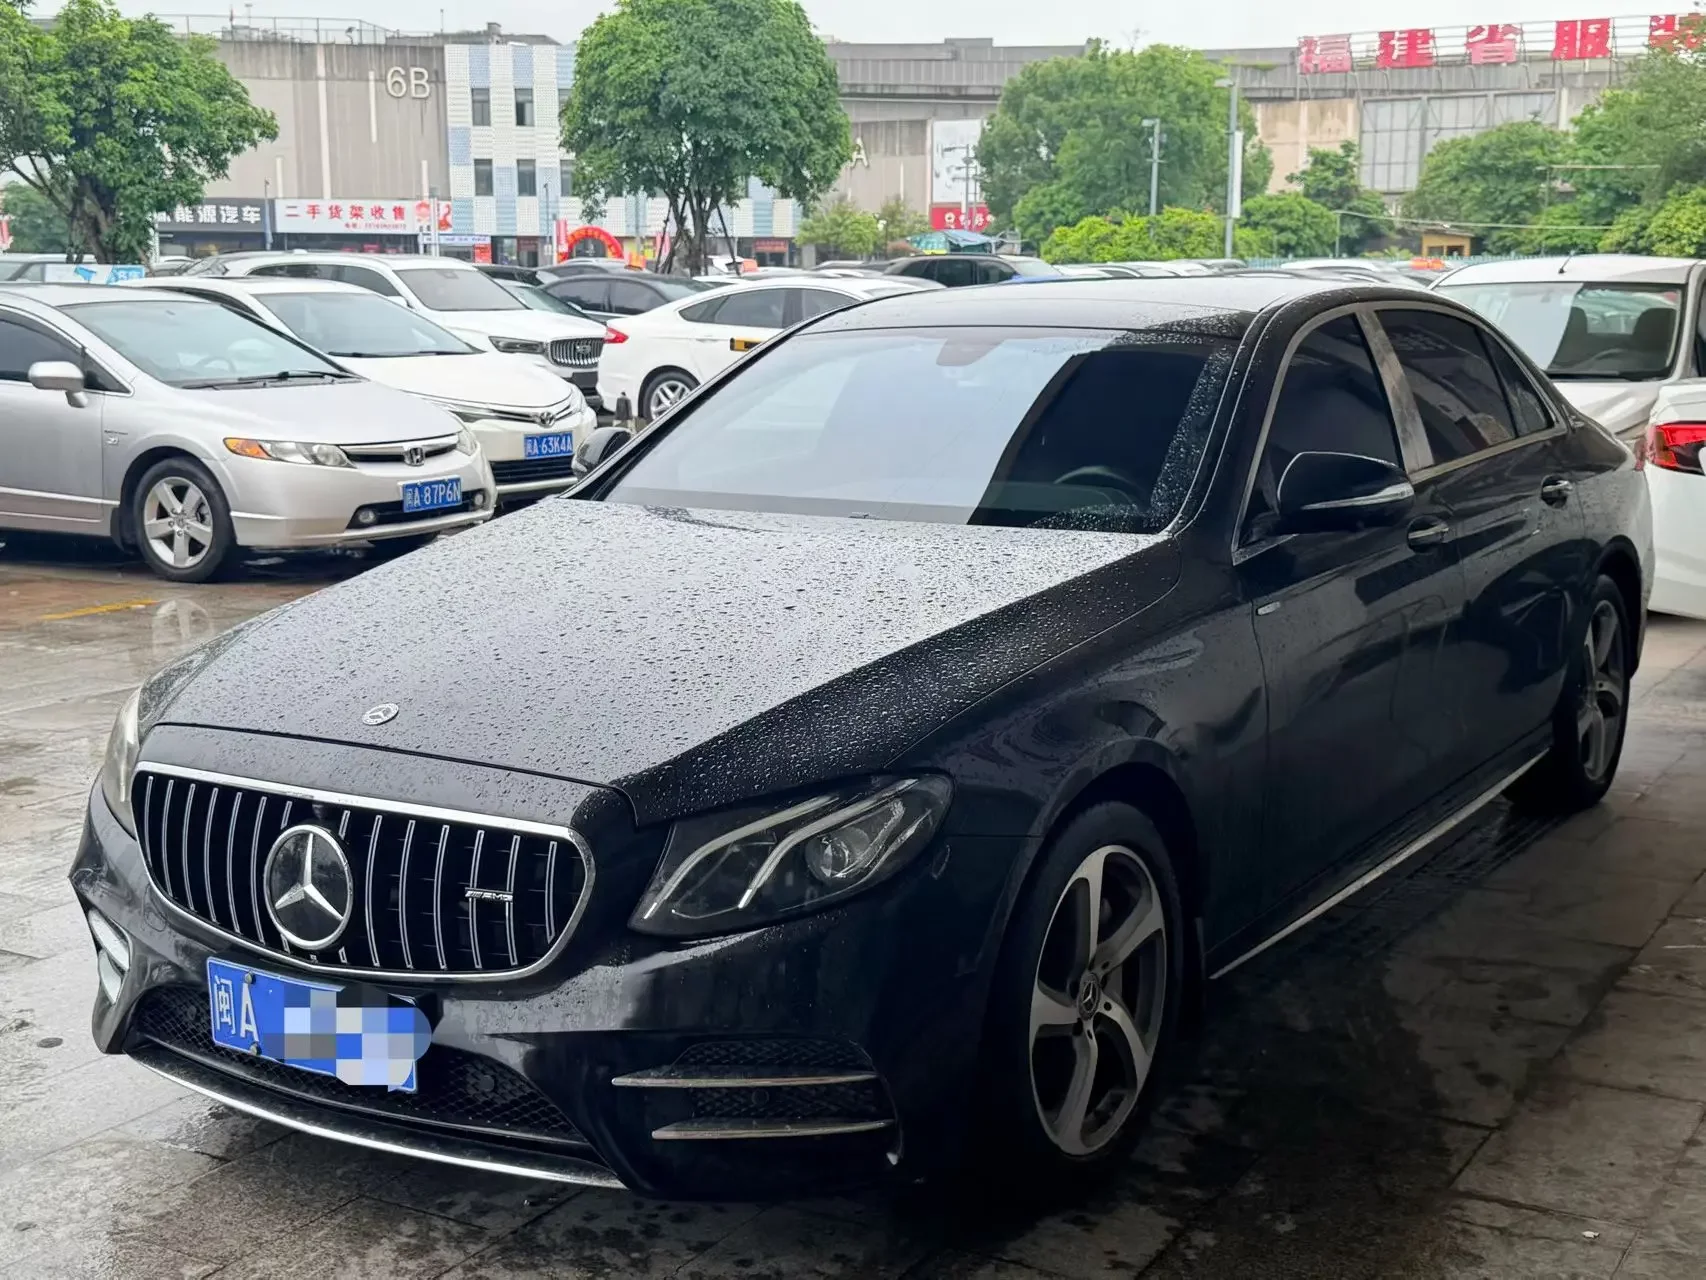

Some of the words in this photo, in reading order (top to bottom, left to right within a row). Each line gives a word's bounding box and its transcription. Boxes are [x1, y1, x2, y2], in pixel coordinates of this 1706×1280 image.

[387, 66, 430, 98] 6B
[285, 204, 406, 221] 二手货架收售
